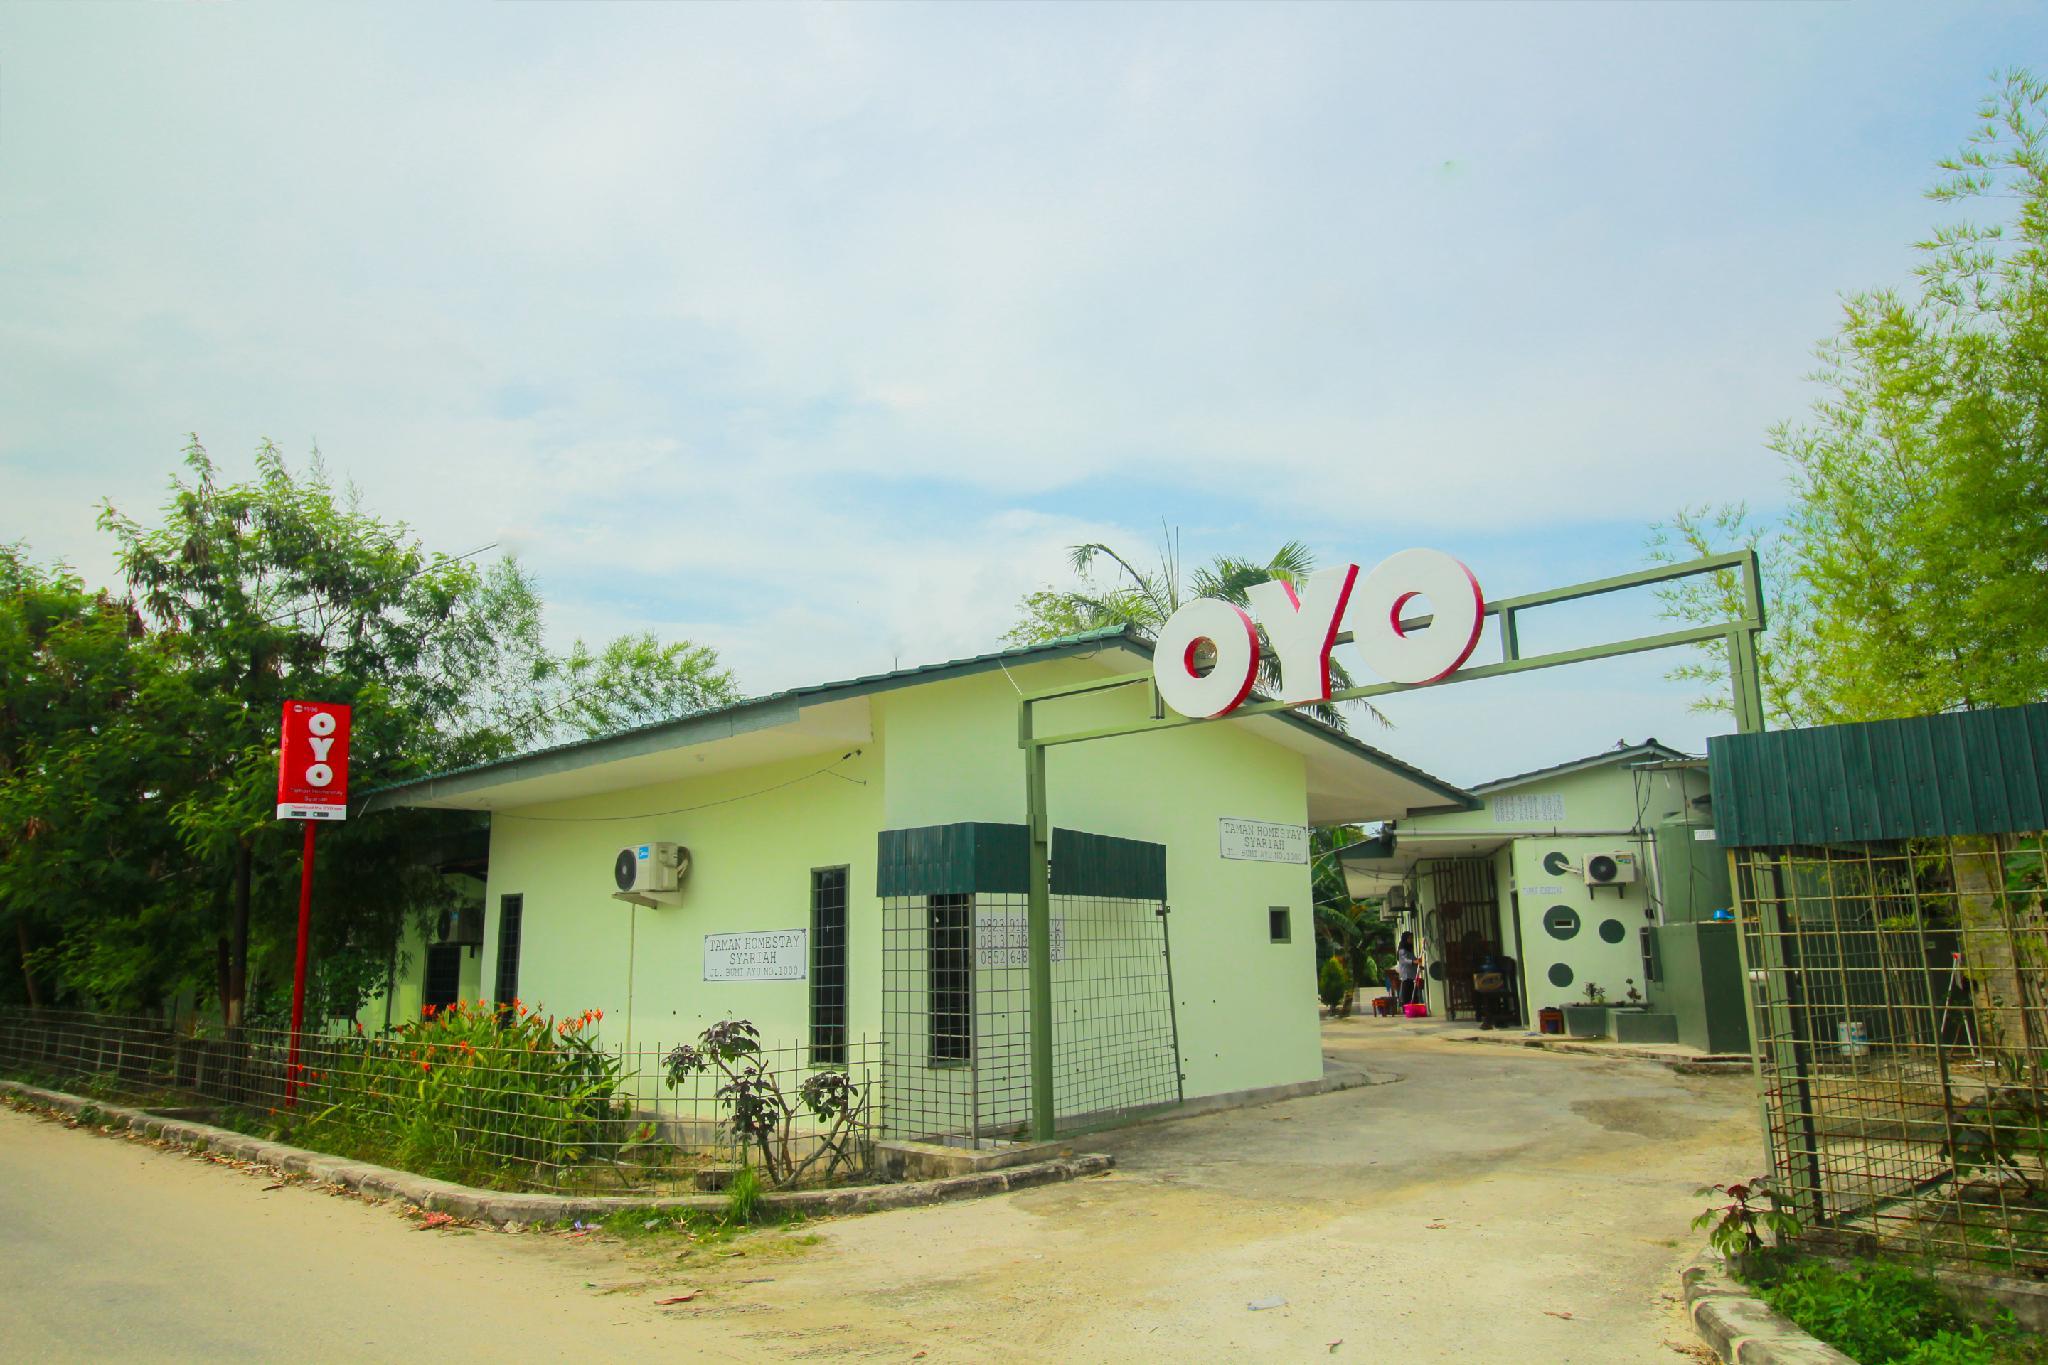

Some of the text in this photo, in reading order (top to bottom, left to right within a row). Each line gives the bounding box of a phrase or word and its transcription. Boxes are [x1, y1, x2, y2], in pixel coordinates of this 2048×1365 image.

[1153, 547, 1484, 719] OYO
[305, 712, 336, 787] OYO
[1224, 822, 1302, 841] TAMAN HOMESTAY
[1244, 836, 1285, 850] SYARIAH
[710, 935, 800, 952] TAMAN HOMESTAY
[729, 951, 777, 965] SYARIAH
[980, 950, 1005, 965] 0852
